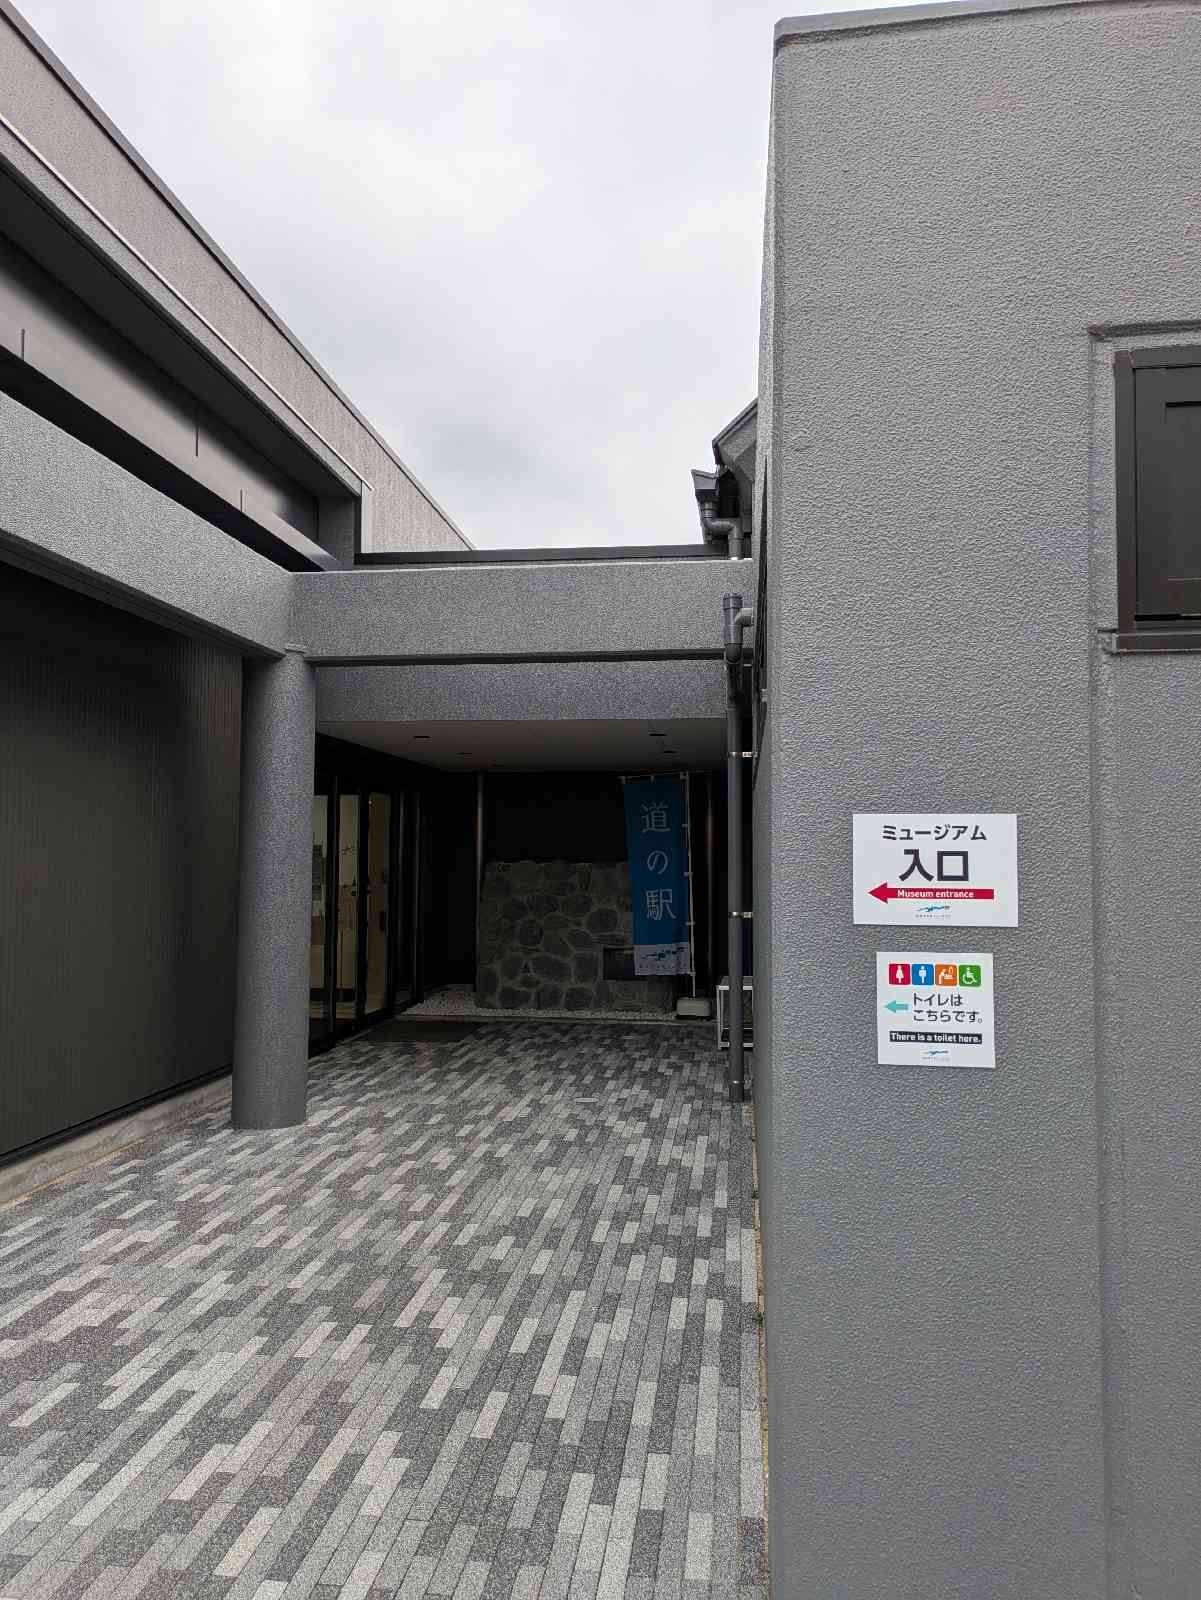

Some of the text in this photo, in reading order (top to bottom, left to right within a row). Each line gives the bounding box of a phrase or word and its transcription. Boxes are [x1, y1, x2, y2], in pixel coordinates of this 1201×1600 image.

[882, 824, 987, 841] ミュージアム
[640, 801, 677, 921] 道の駅
[899, 848, 969, 882] 入口
[897, 889, 974, 898] Museum entrance
[913, 992, 963, 1007] トイレは
[913, 1009, 982, 1024] こちらです。
[891, 1032, 916, 1041] There
[917, 1033, 925, 1041] is
[934, 1033, 957, 1043] toilet
[958, 1034, 981, 1044] here.
